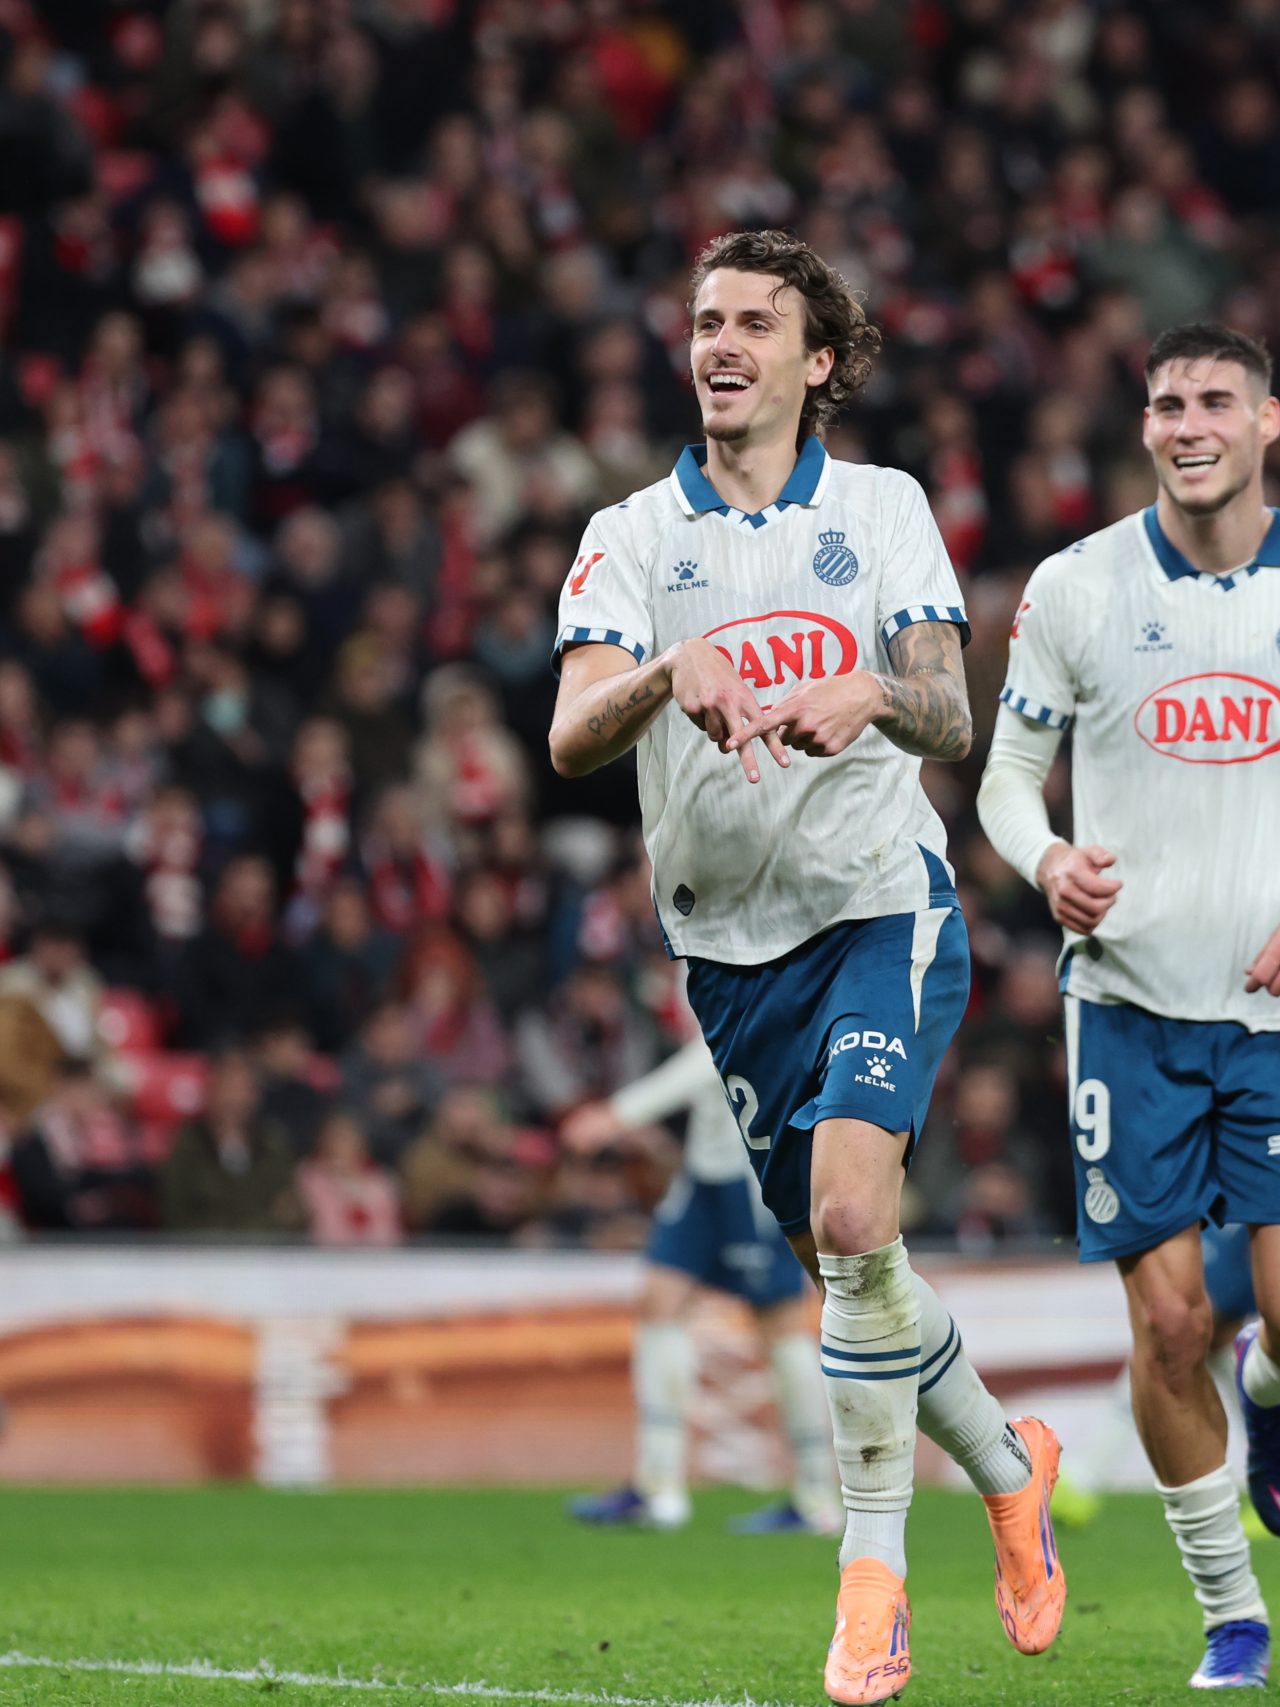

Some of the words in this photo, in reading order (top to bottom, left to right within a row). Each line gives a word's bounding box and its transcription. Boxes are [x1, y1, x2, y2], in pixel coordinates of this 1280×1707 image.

[823, 547, 855, 562] ESPANYOL
[667, 580, 709, 592] KELME
[823, 567, 857, 584] BARCELONA
[715, 630, 826, 688] ANI
[1153, 696, 1273, 743] DANI
[829, 1030, 908, 1063] KODA
[854, 1074, 897, 1093] KELME
[1075, 1078, 1111, 1162] 9
